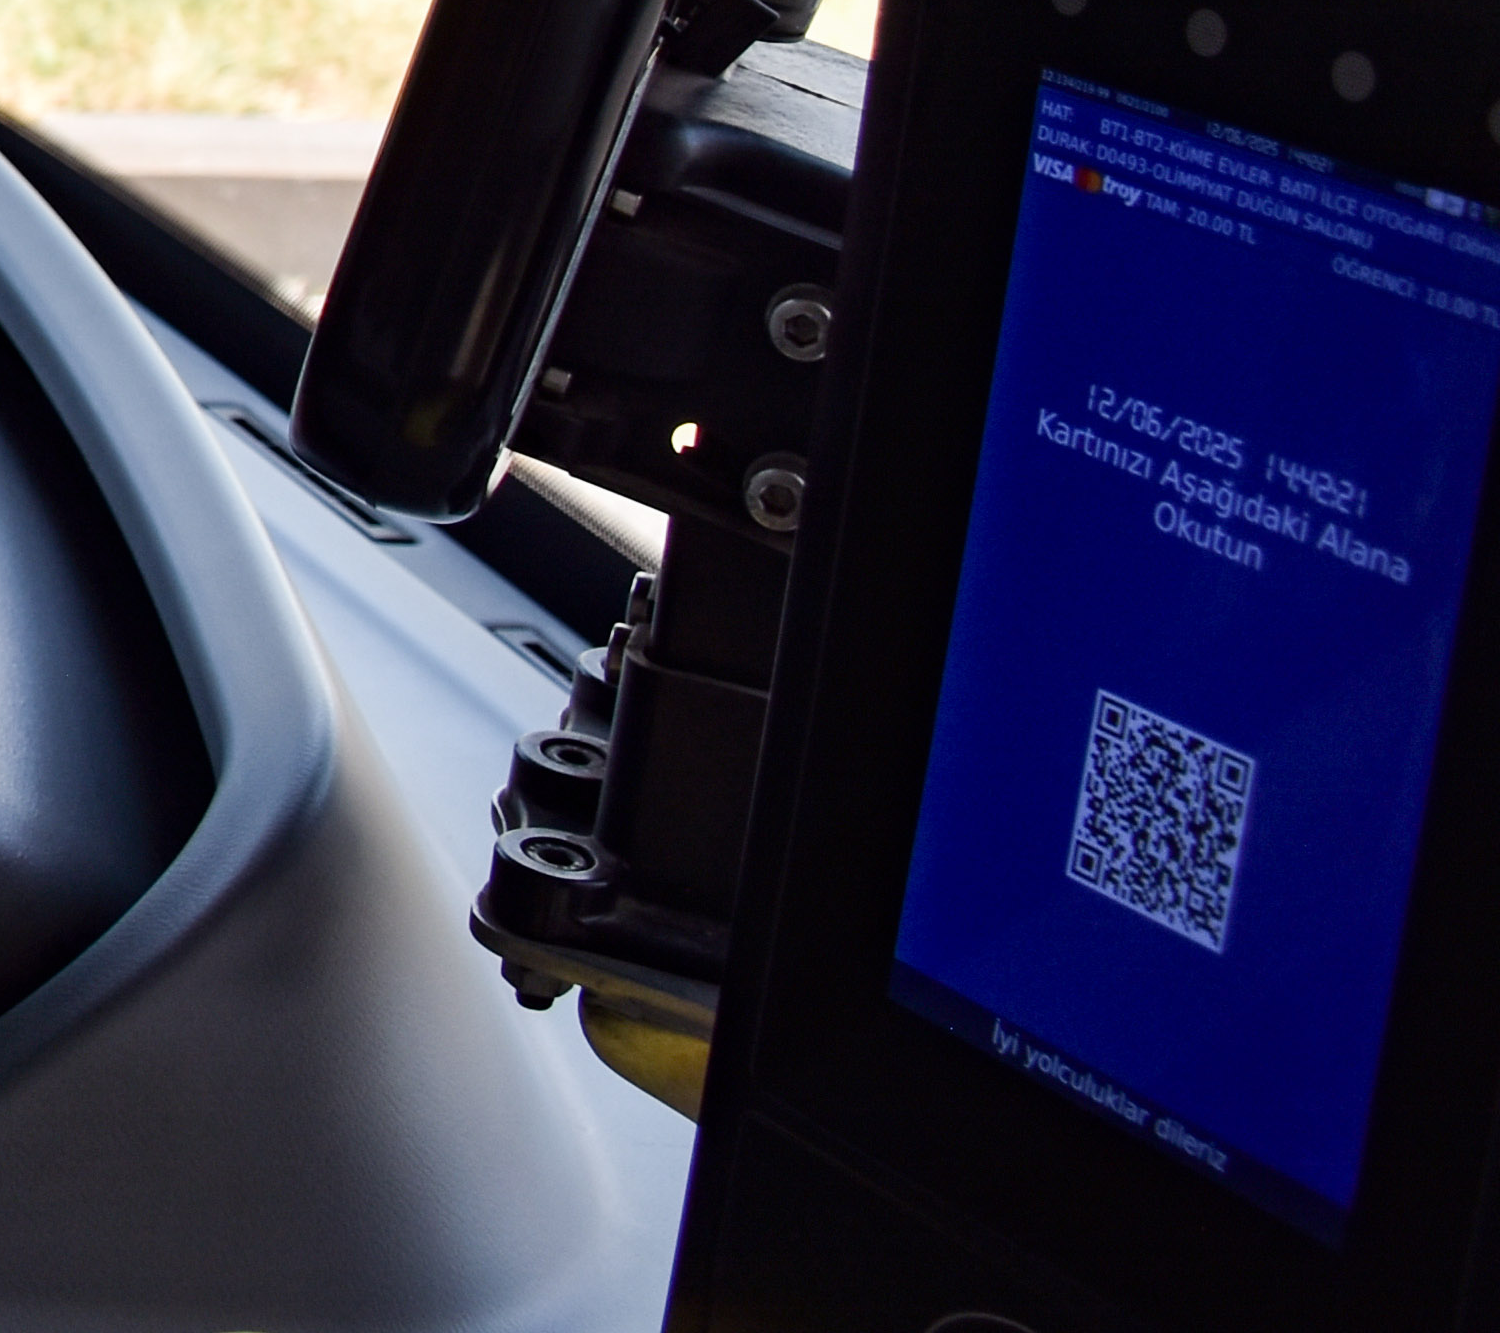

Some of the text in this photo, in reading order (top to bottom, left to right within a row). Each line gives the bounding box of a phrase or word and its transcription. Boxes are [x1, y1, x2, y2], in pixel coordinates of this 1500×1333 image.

[1041, 99, 1074, 122] HAT:
[1037, 124, 1093, 157] DURAK:
[1033, 152, 1075, 184] VISA
[1102, 175, 1143, 207] troy
[1146, 191, 1181, 219] TAM:
[1238, 222, 1257, 245] TL
[1088, 384, 1245, 471] 12/06/2025
[1036, 408, 1412, 586] Kartınızı Aşağıdaki Alana
[1153, 500, 1265, 572] Okutun
[1023, 1044, 1151, 1126] yolculuklar
[1153, 1116, 1228, 1173] dileriz
